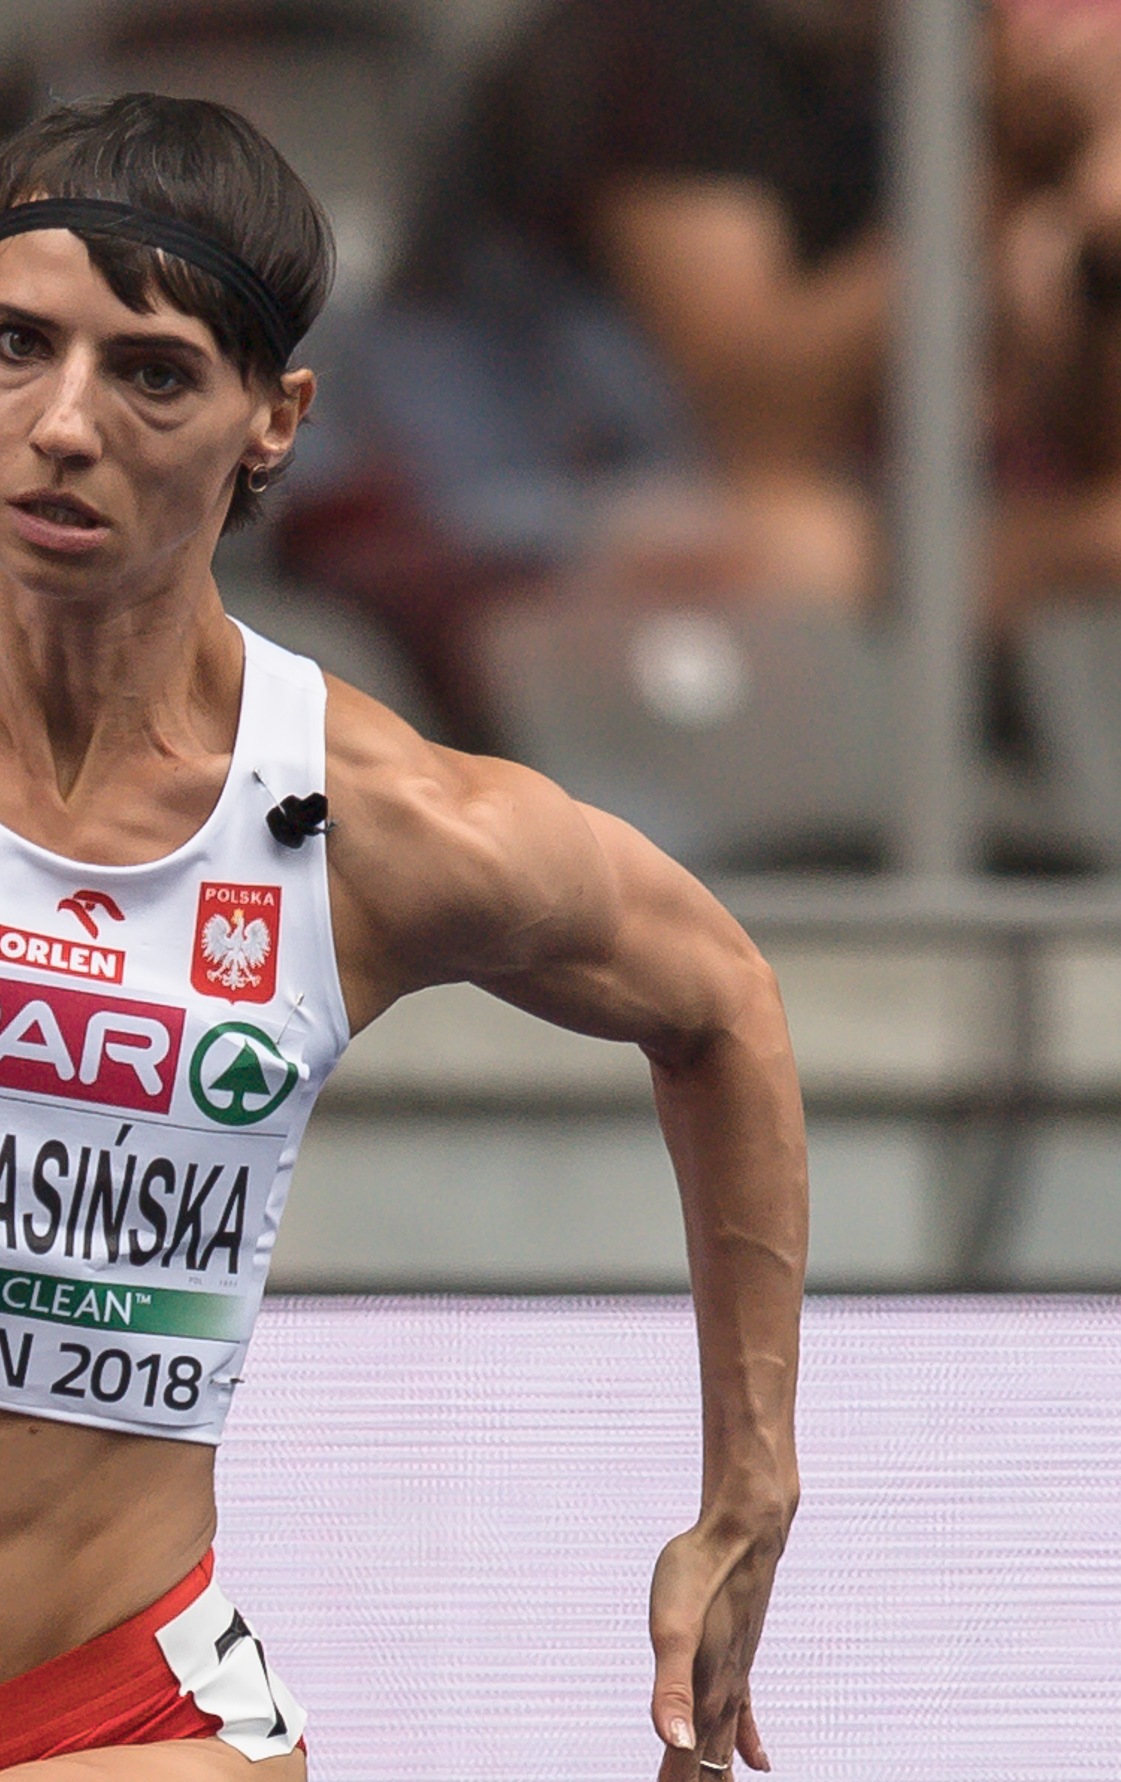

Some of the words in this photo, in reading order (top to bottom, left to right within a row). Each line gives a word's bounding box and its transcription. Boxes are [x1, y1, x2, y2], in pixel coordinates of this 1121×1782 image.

[204, 887, 275, 907] POLSKA
[0, 930, 118, 979] ORLEN
[51, 1342, 204, 1411] 2018
